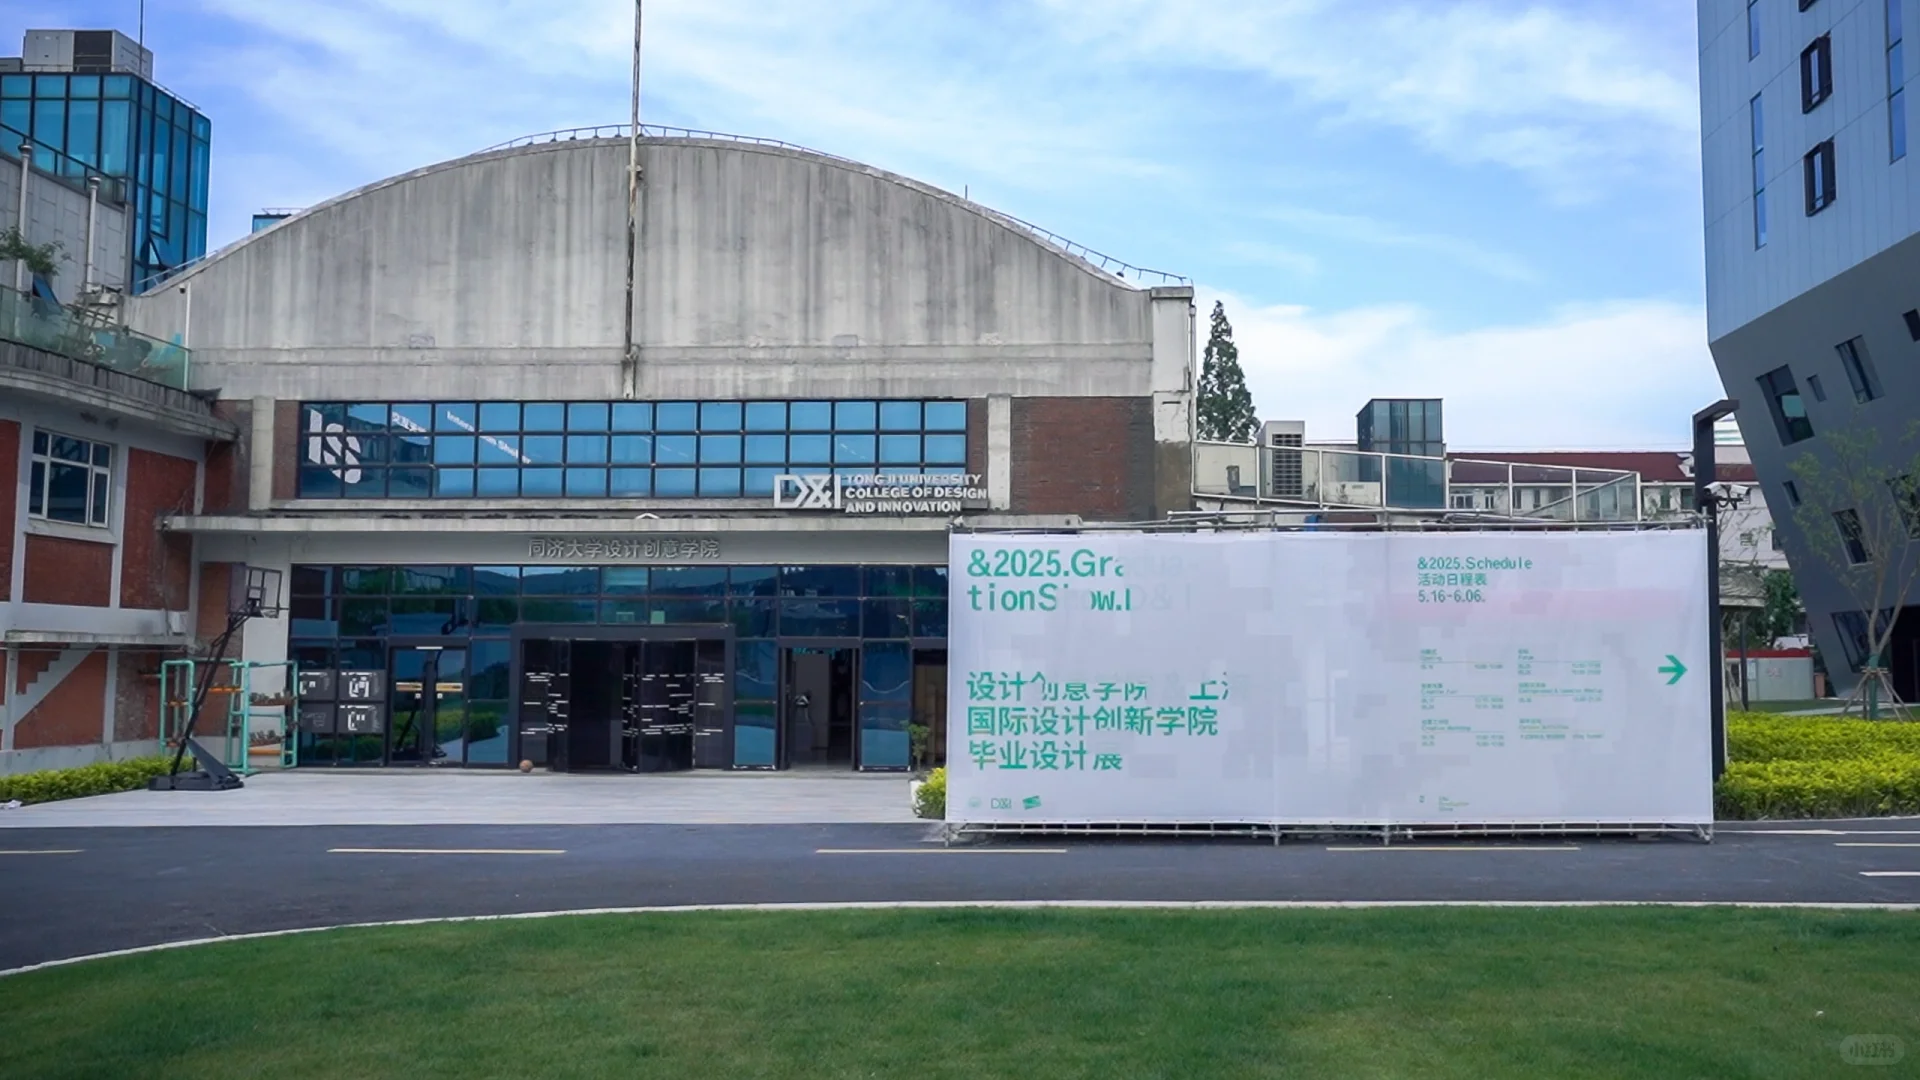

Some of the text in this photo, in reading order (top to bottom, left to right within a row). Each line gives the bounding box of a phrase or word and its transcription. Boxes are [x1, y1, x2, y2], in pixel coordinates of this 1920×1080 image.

[899, 474, 982, 485] UNIVERSITY
[845, 486, 987, 499] COLLEGE OF DESIGN
[845, 500, 962, 513] AND INNOVATION
[528, 538, 720, 558] 同济大学设计创意学院
[1417, 556, 1533, 570] &2025.Schedule
[1417, 573, 1488, 587] 活动日程表
[967, 705, 1218, 736] 国际设计创新学院
